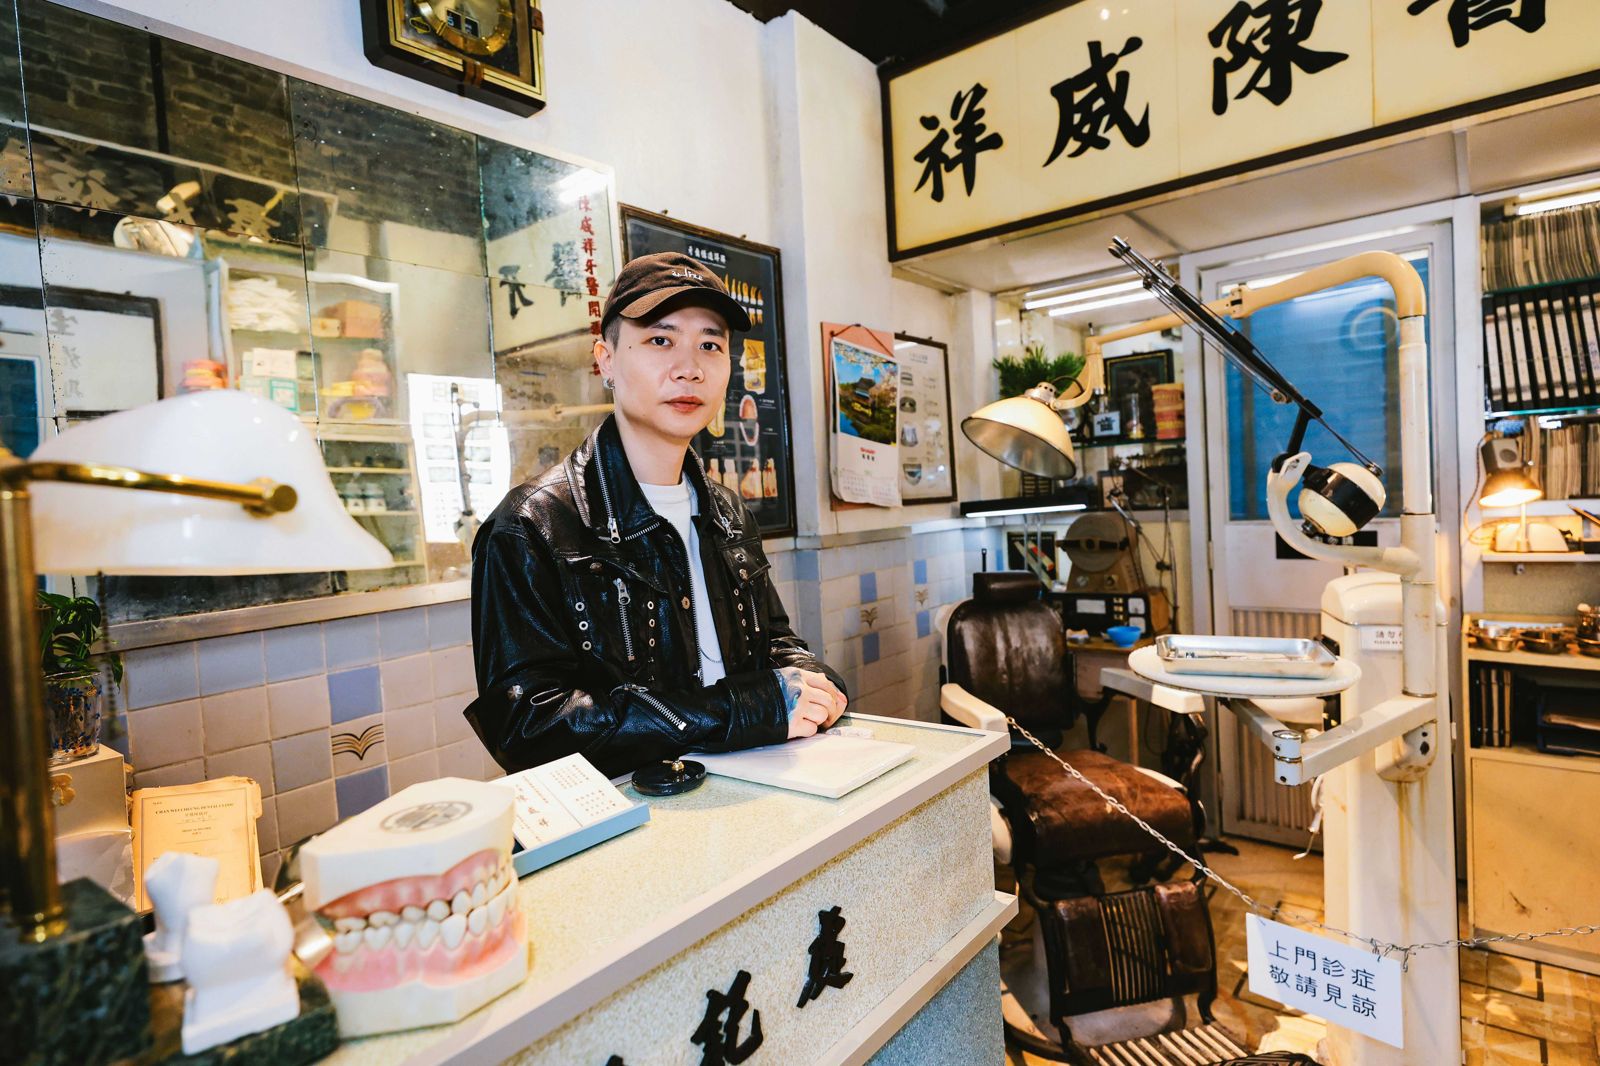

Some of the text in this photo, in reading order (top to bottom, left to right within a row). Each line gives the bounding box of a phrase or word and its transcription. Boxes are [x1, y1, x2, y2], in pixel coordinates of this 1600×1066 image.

[914, 0, 1546, 202] 陳威祥
[1268, 940, 1376, 991] 上門診症
[1269, 964, 1377, 1020] 敬請見諒
